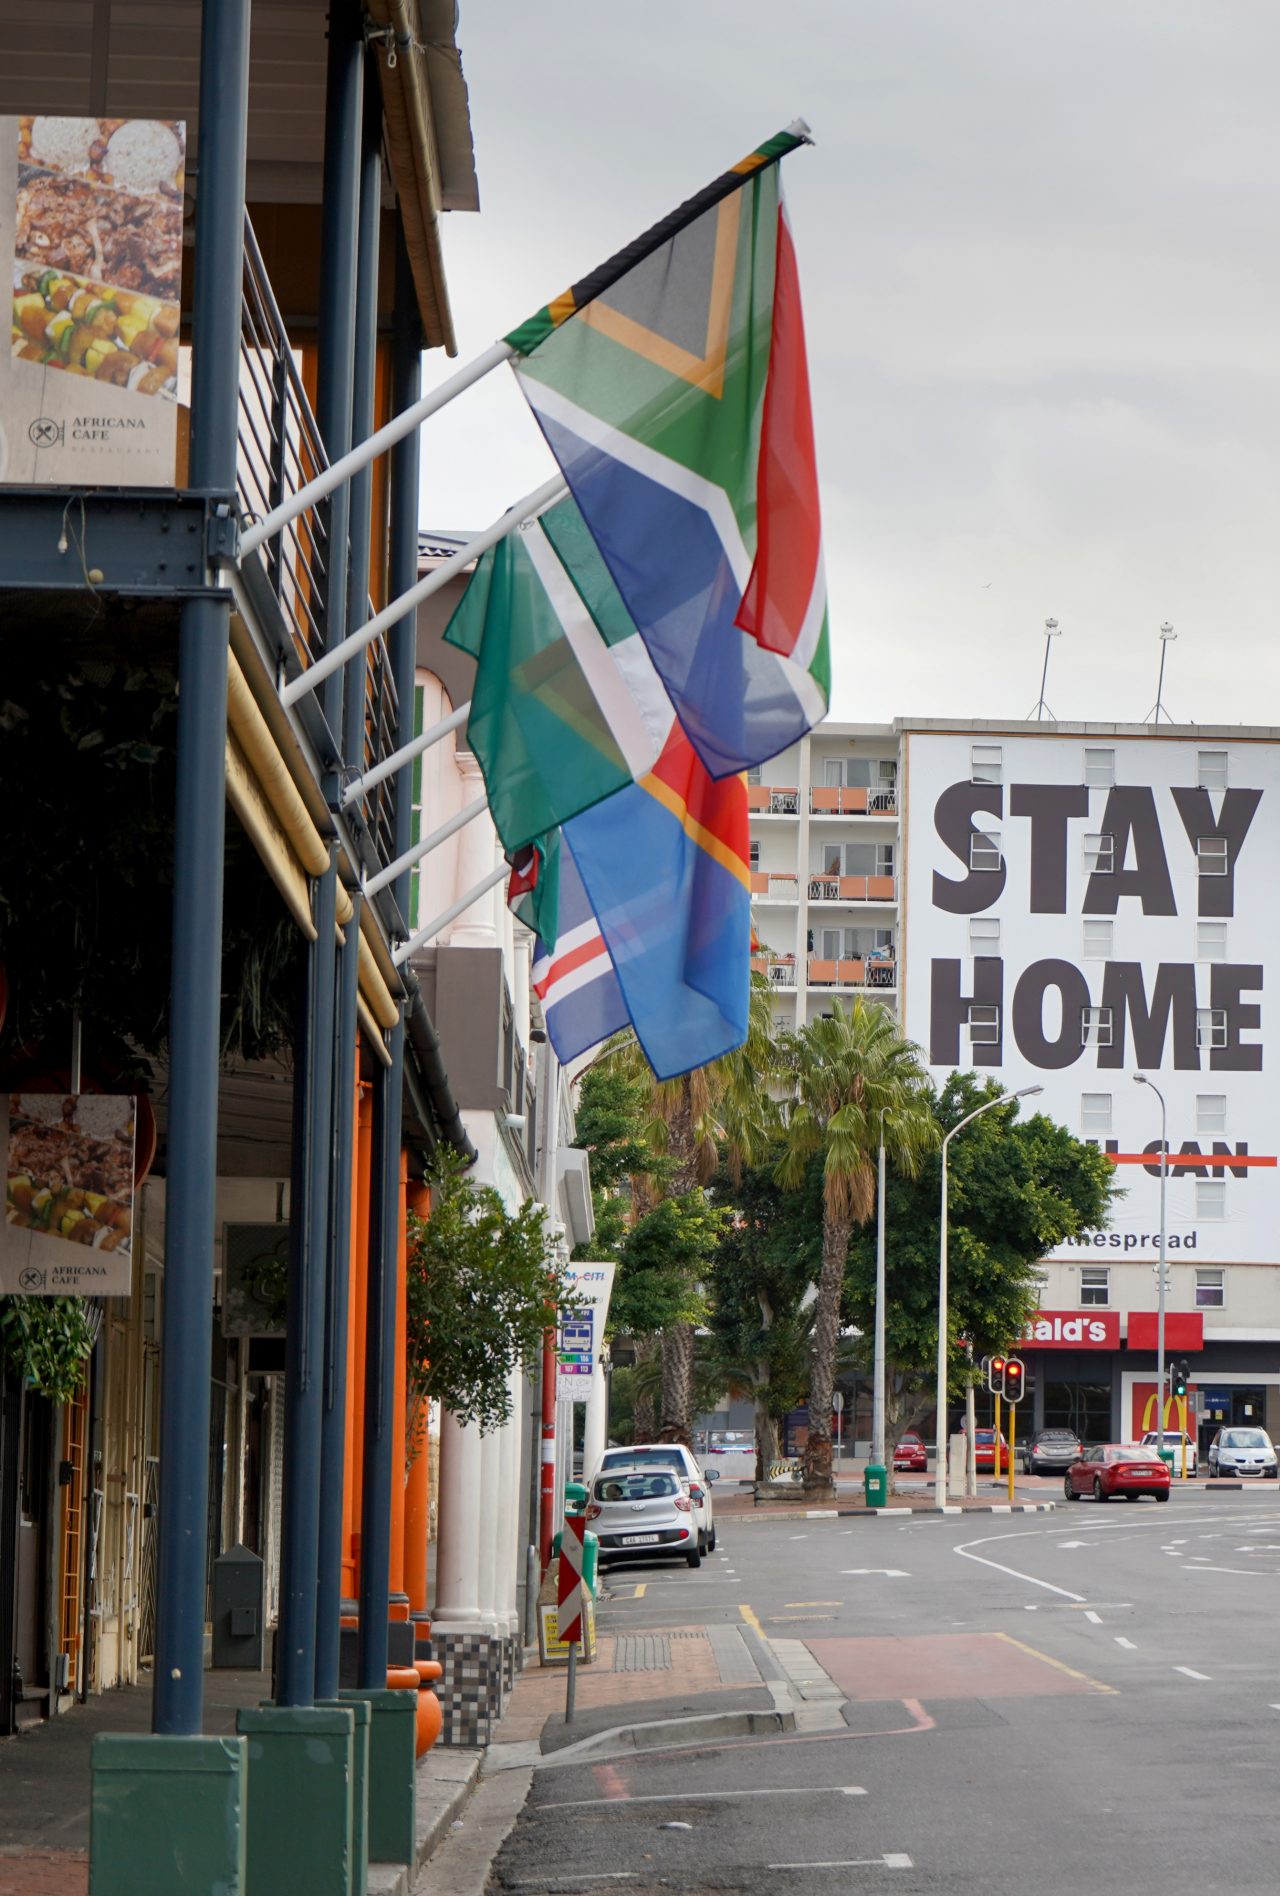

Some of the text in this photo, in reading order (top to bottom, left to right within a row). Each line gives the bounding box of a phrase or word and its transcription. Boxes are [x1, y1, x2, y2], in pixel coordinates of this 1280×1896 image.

[72, 417, 146, 429] AFRICANA
[72, 430, 110, 441] CAFE
[932, 778, 1264, 918] STAY
[930, 958, 1264, 1072] HOME
[1142, 1139, 1249, 1179] CAN
[52, 1266, 107, 1276] AFRICANA
[52, 1276, 80, 1284] CAFE
